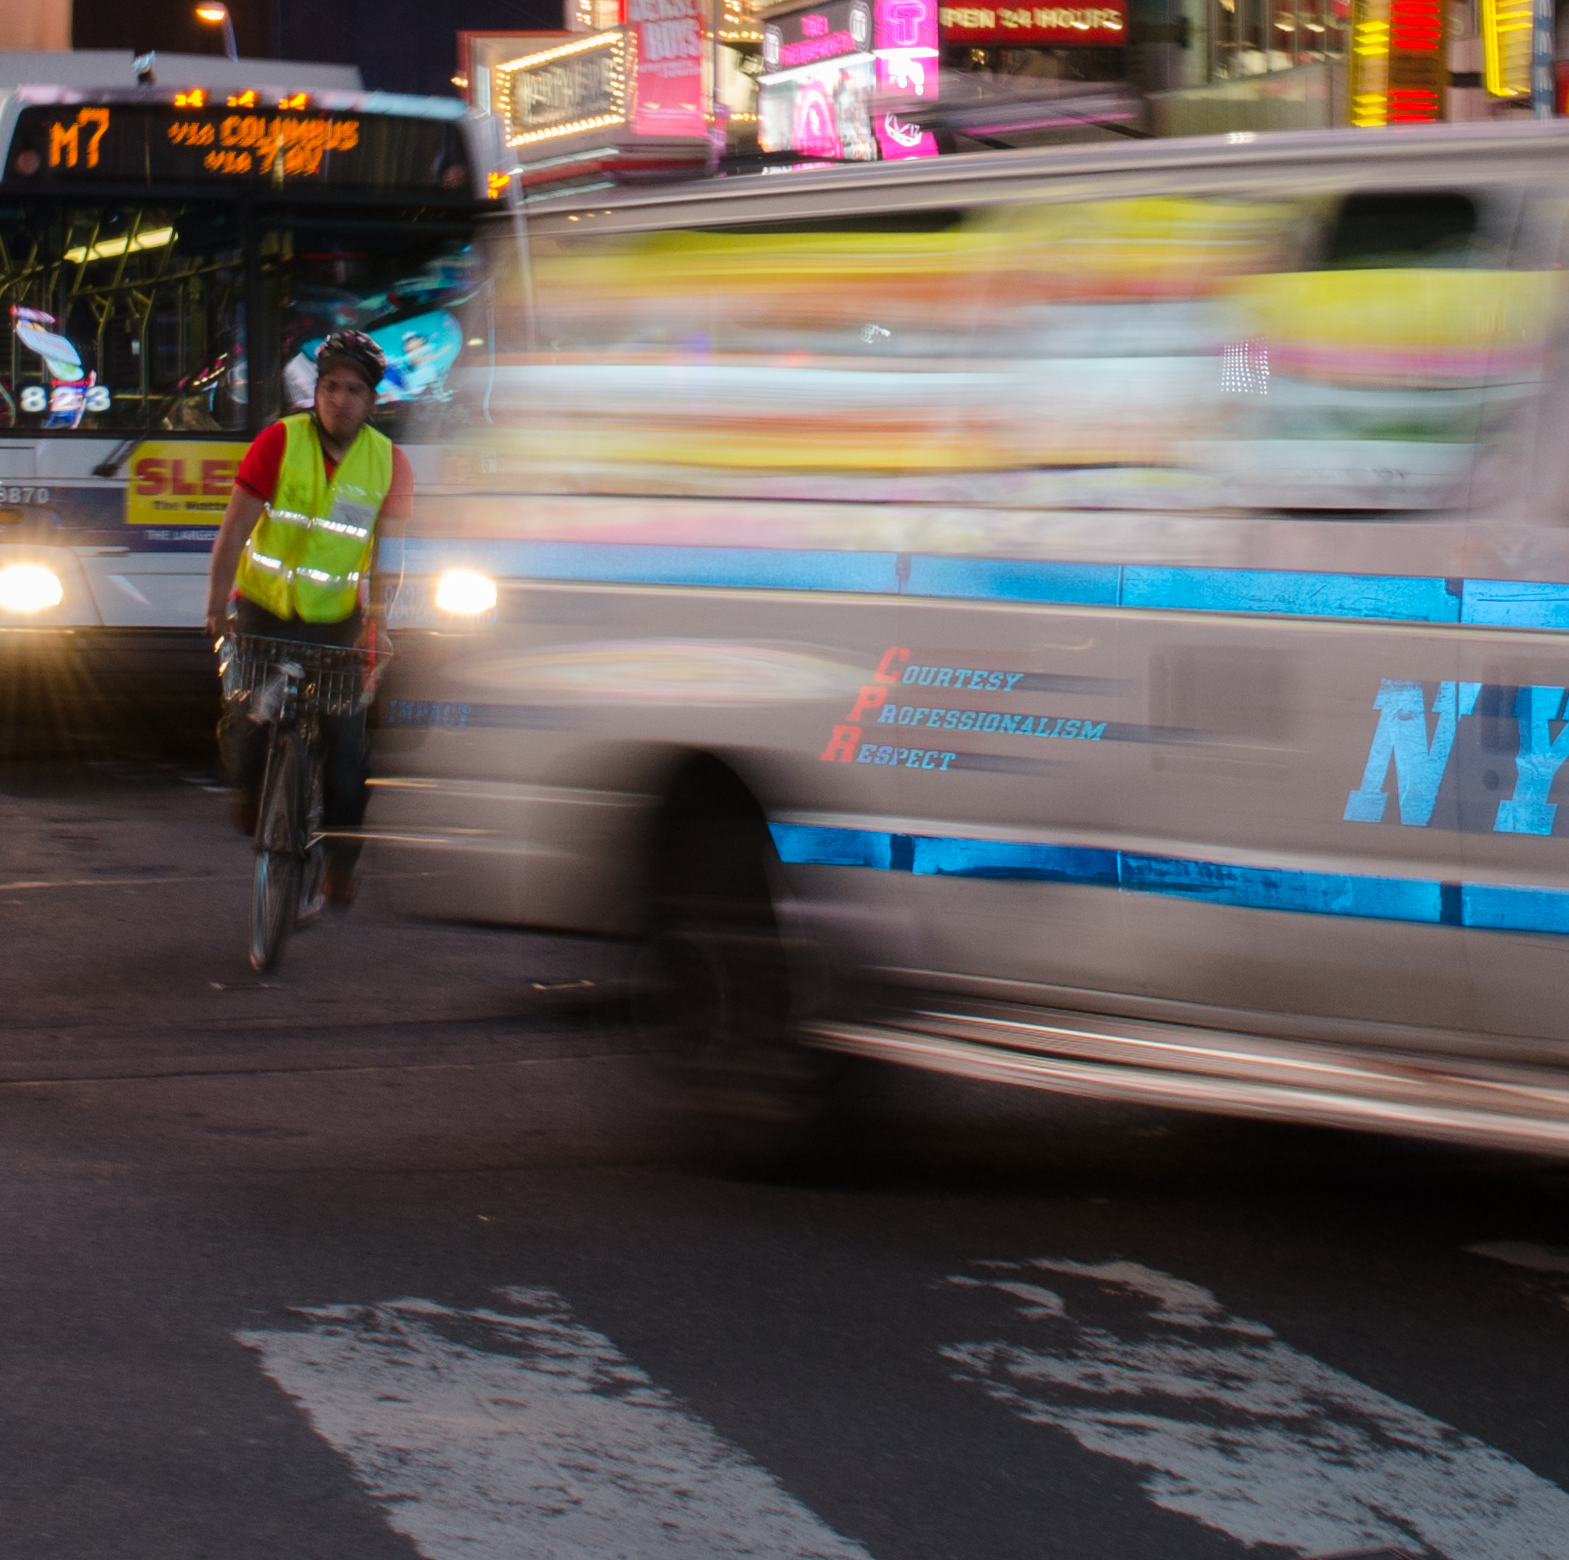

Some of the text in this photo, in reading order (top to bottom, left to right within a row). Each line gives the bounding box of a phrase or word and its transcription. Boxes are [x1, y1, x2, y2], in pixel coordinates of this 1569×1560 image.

[640, 16, 702, 61] BOYS
[938, 6, 996, 29] PEN
[1033, 6, 1124, 32] HOURS
[49, 107, 110, 169] M7
[220, 116, 359, 151] COLUMBUS
[20, 385, 112, 412] 823
[135, 457, 245, 496] SLE
[873, 646, 1024, 691] COURTESY
[845, 685, 1108, 741] PROFESSIONALISM
[820, 724, 956, 771] RESPECT
